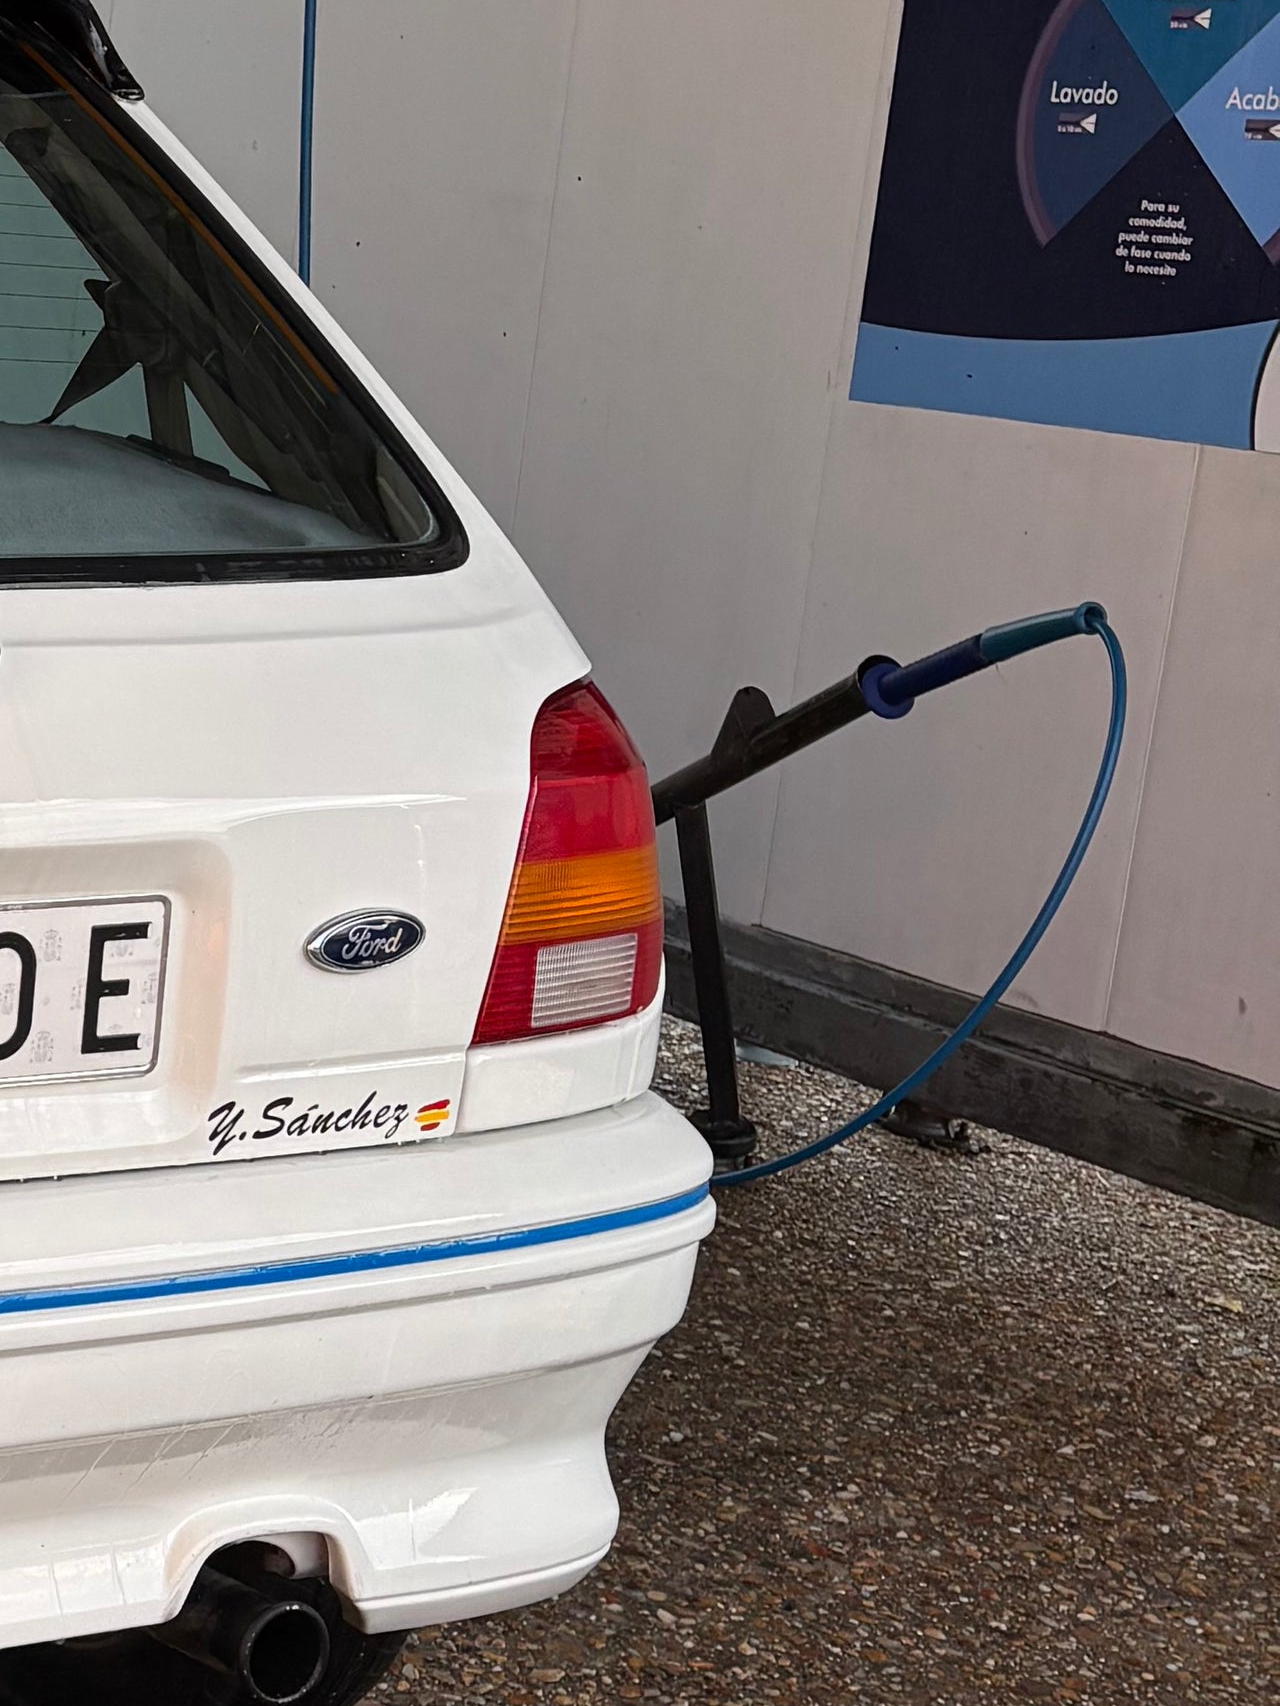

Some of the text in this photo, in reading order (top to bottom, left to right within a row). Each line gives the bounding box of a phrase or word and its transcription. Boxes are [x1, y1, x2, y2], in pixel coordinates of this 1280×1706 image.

[1050, 80, 1119, 105] Lavado
[1141, 199, 1180, 213] Para su
[1118, 230, 1194, 246] puede cambiar
[1115, 244, 1129, 257] de
[1154, 248, 1191, 262] cuando
[341, 922, 403, 960] Ford
[81, 921, 151, 1055] E
